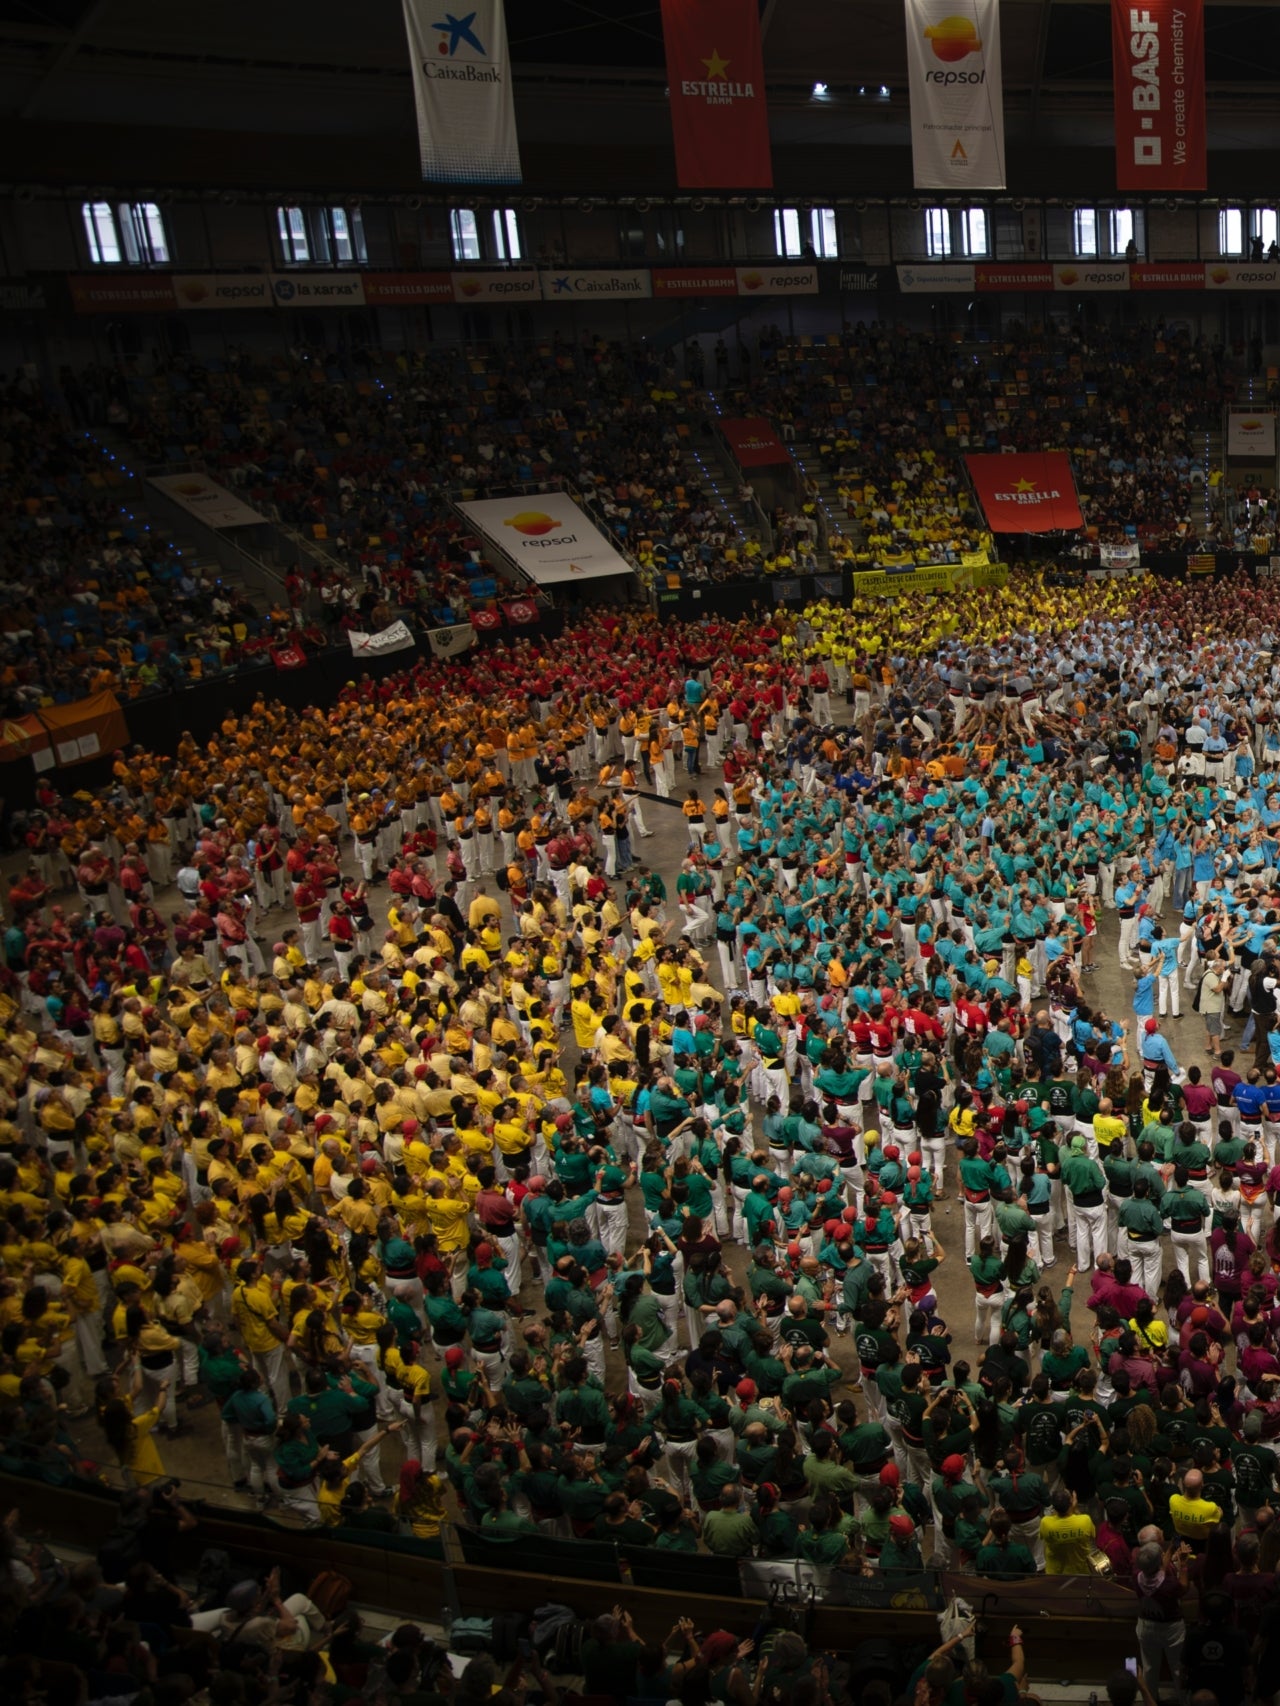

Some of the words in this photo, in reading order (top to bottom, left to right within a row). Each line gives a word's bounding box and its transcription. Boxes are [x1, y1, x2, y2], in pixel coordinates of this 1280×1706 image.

[1171, 9, 1187, 84] chemistry
[1130, 9, 1161, 111] BASF
[422, 61, 501, 84] CaixaBank
[925, 69, 986, 86] repsol
[682, 81, 755, 98] ESTRELLA
[1173, 86, 1186, 139] create
[1173, 143, 1186, 165] We
[667, 278, 709, 288] ESTRELLA
[770, 274, 812, 287] repsol
[988, 274, 1025, 283] ESTRELLA
[1084, 271, 1125, 284] repsol
[1142, 273, 1179, 282] ESTRELLA
[1236, 271, 1276, 284] repsol
[215, 284, 264, 298] repsol
[297, 283, 309, 295] la
[489, 280, 535, 293] repsol
[574, 278, 641, 293] CaixaBank
[994, 490, 1061, 501] ESTRELLA
[522, 534, 578, 549] repsol
